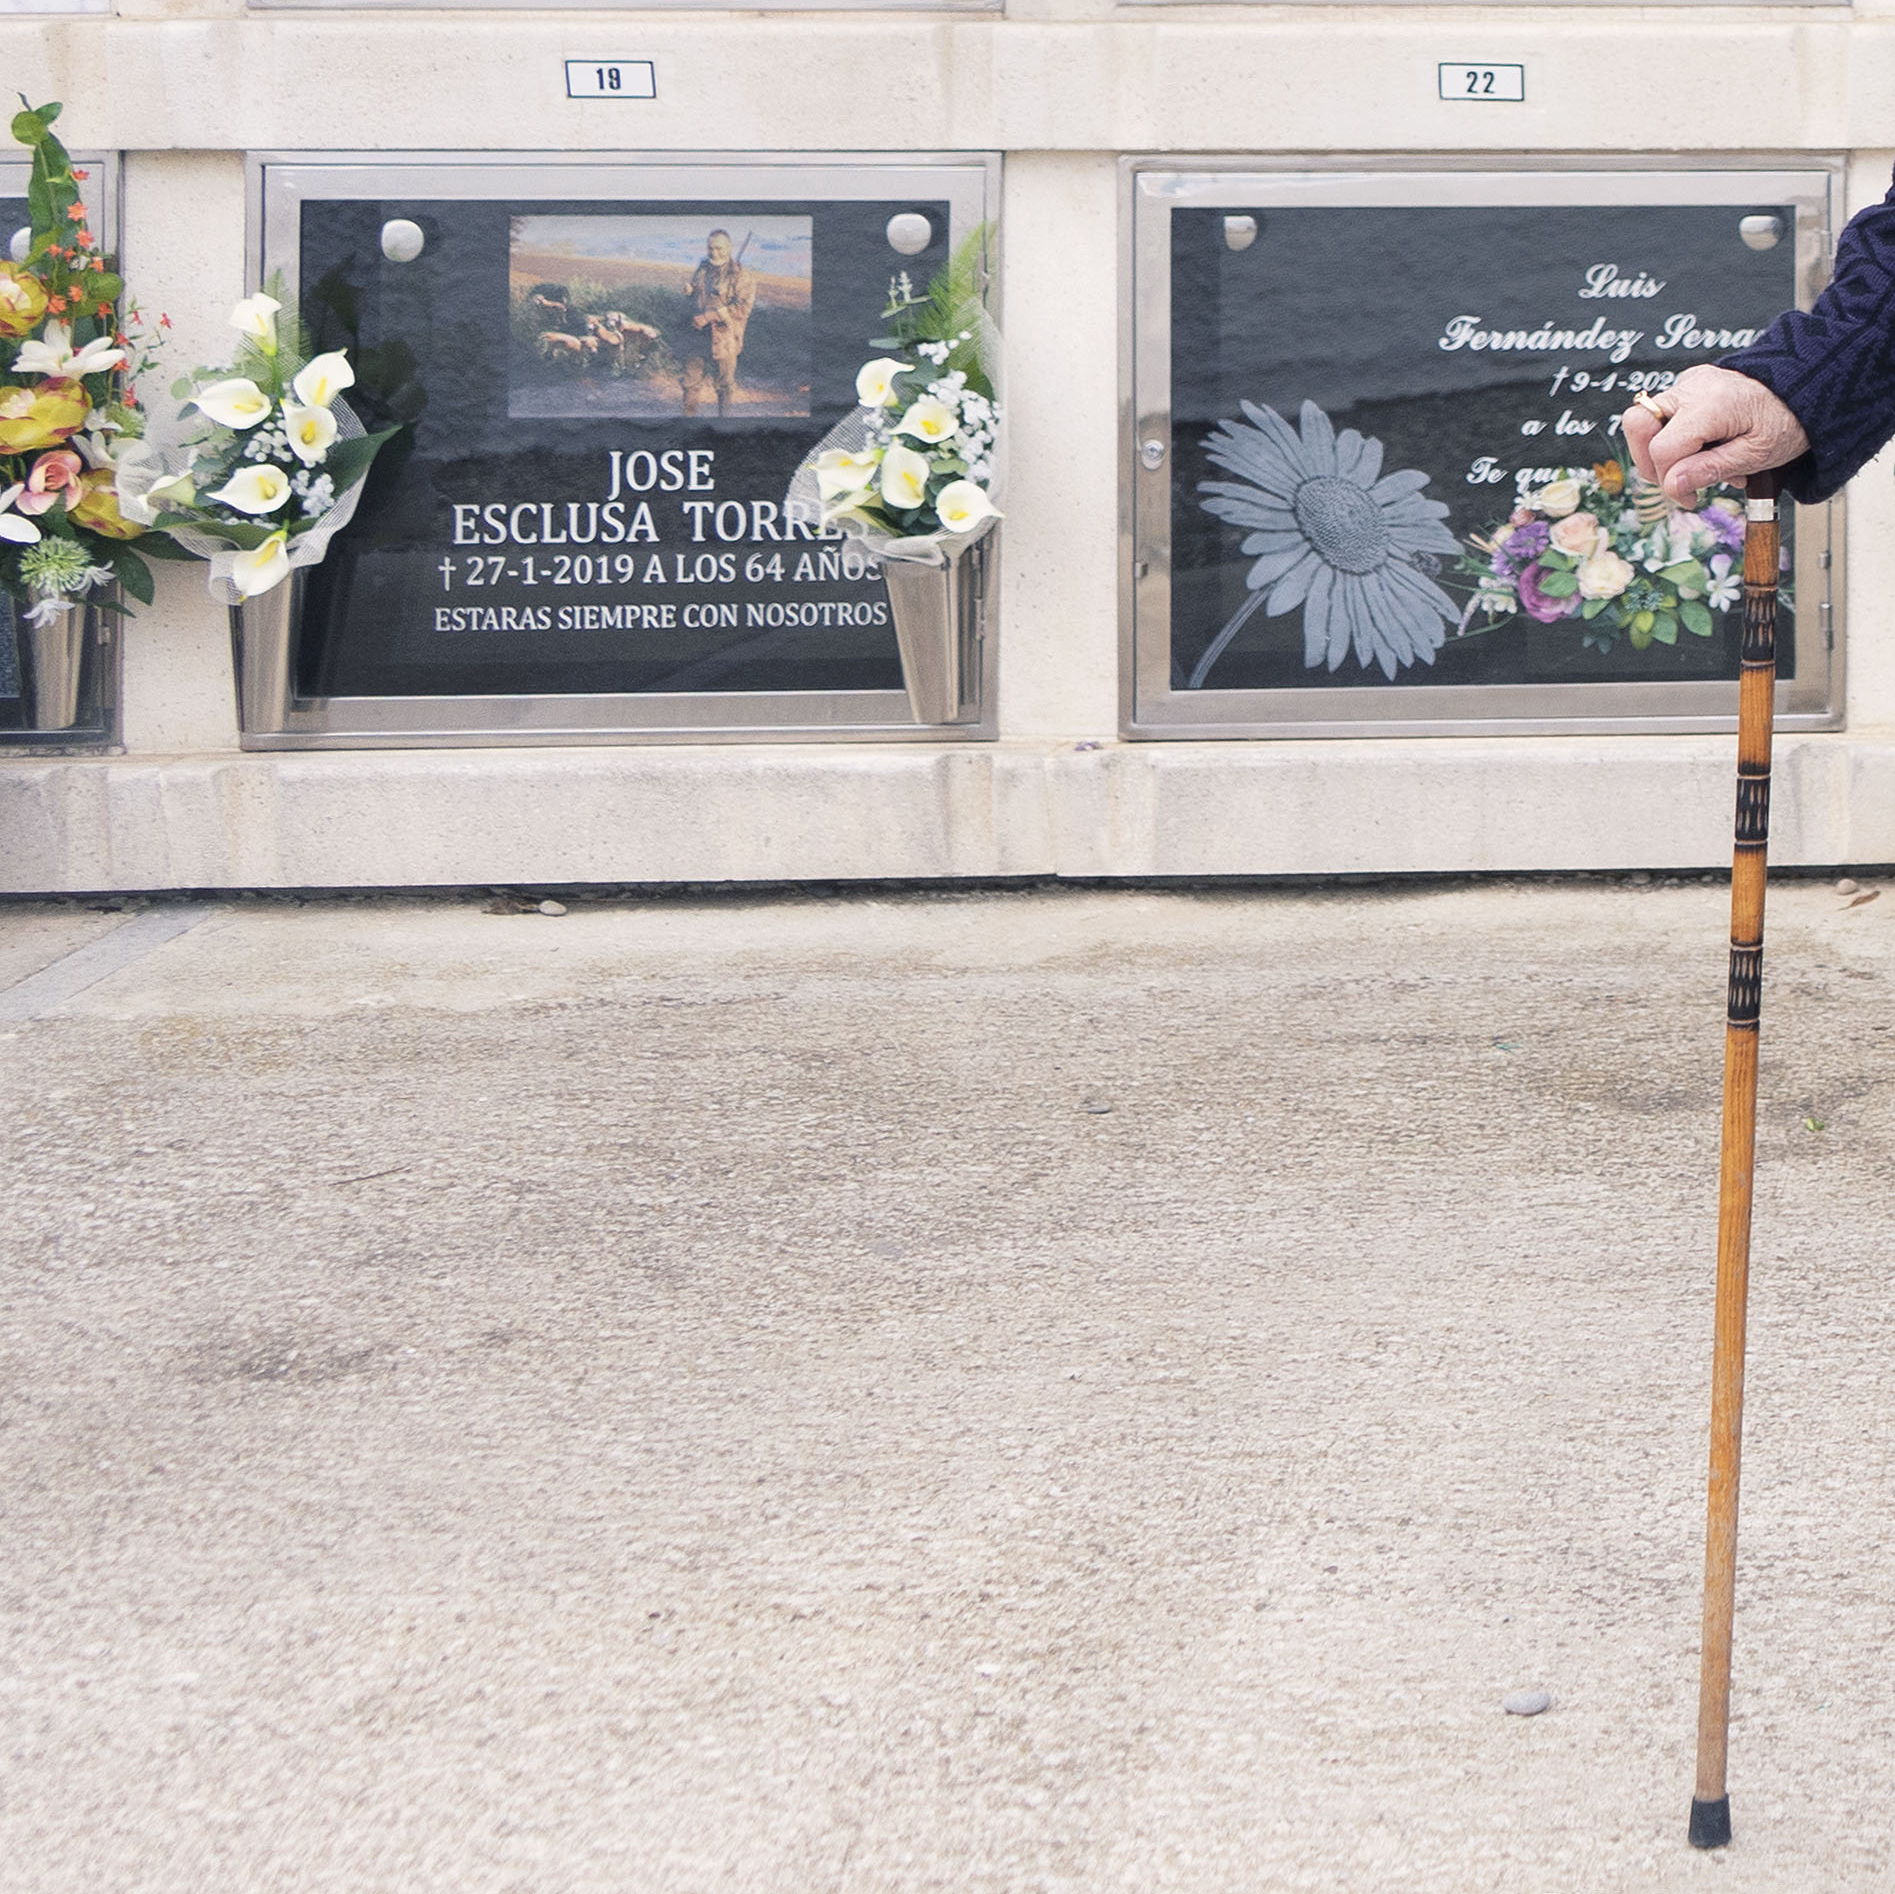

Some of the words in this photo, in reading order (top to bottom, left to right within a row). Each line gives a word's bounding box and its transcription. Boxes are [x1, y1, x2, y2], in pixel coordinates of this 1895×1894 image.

[596, 67, 622, 91] 19
[1466, 71, 1495, 94] 22
[1578, 263, 1667, 299] Luis
[1438, 315, 1645, 364] Fernández
[1555, 410, 1598, 436] los
[607, 450, 715, 500] JOSE
[452, 501, 660, 544] ESCLUSA
[466, 555, 634, 585] 27-1-2019
[643, 556, 667, 584] A
[676, 554, 736, 583] LOS
[745, 554, 785, 583] 64
[793, 546, 883, 582] AÑOS
[434, 606, 551, 631] ESTARAS
[558, 605, 677, 629] SIEMPRE
[683, 604, 739, 628] CON
[746, 602, 887, 626] NOSOTROS
